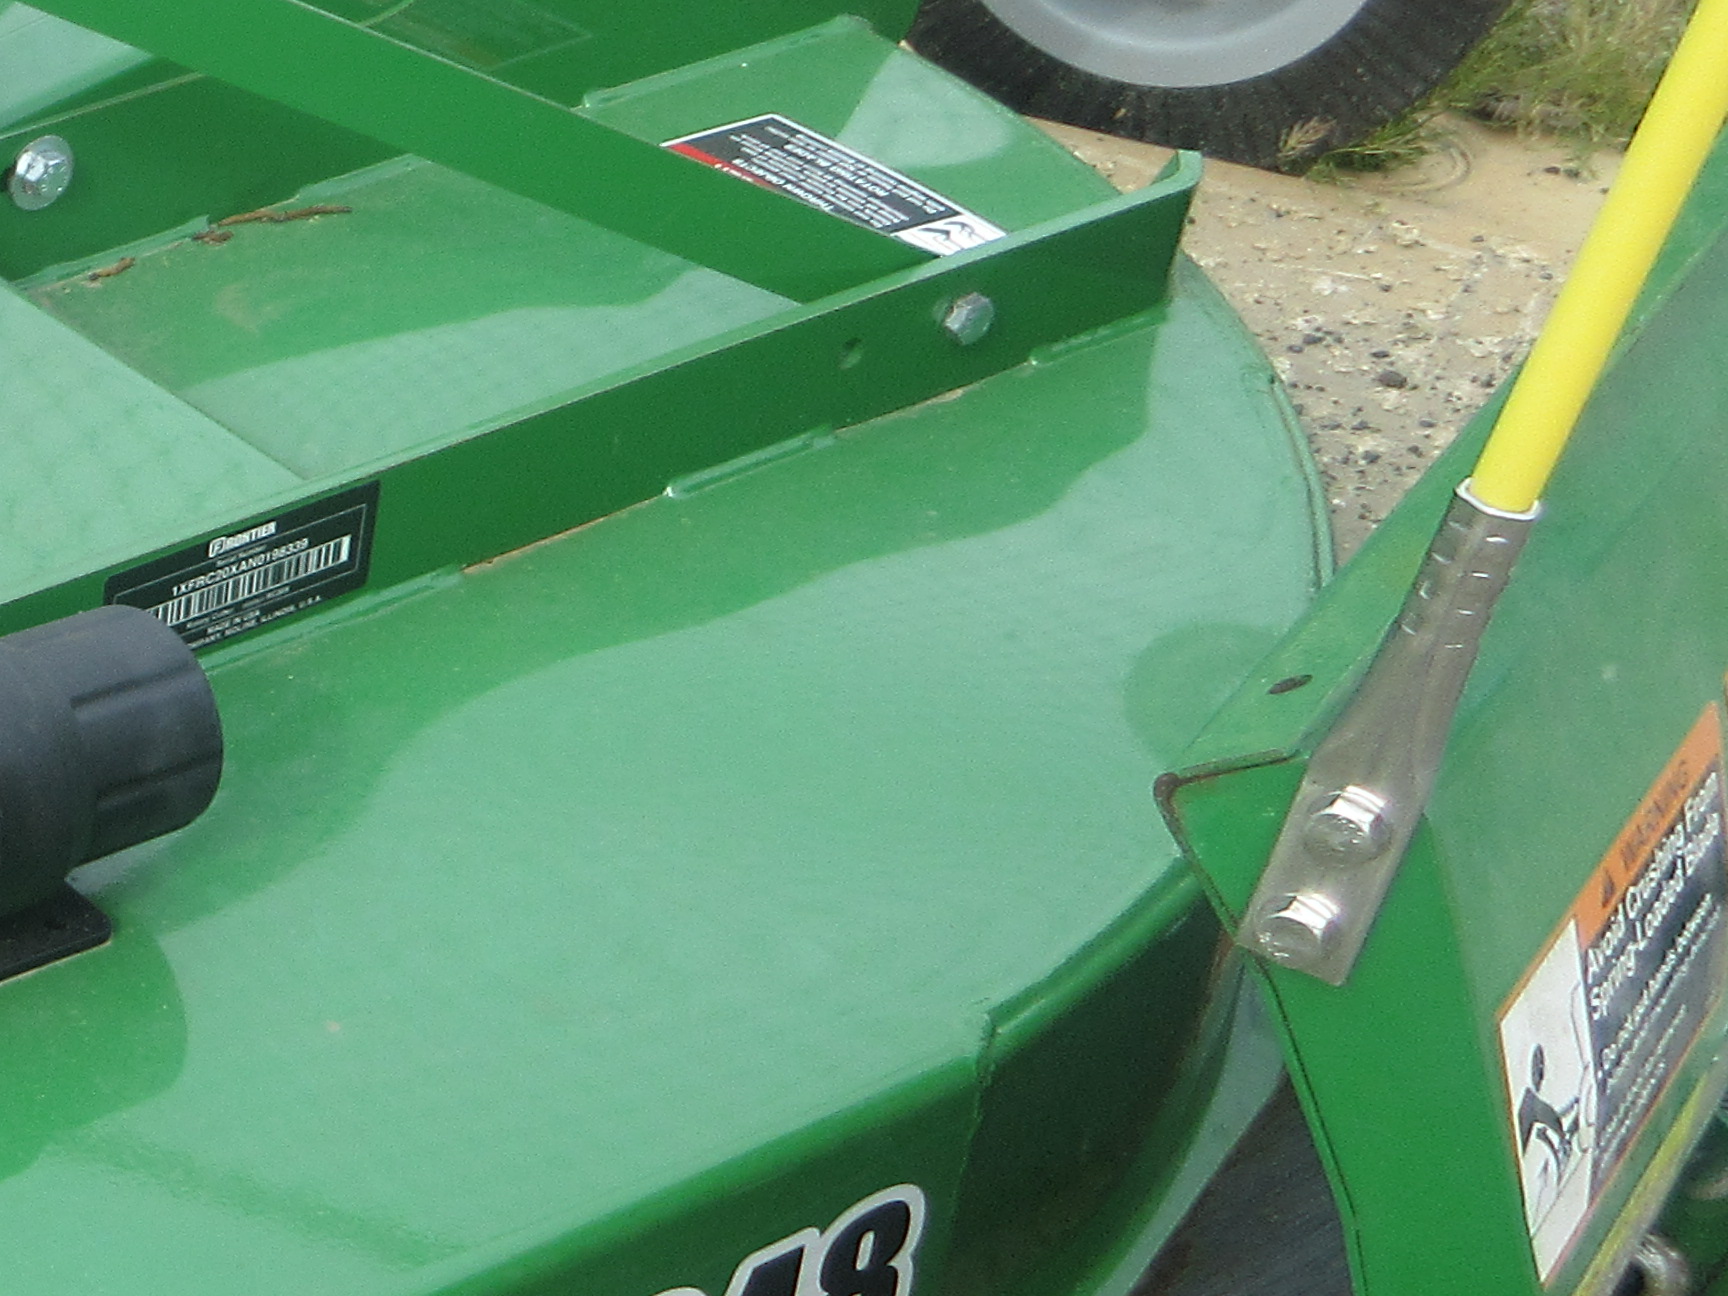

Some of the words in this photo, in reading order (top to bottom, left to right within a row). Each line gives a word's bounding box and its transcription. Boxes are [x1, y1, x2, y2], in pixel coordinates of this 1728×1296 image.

[208, 521, 277, 558] FRONTIER
[1587, 903, 1625, 983] Avoid
[1626, 823, 1685, 919] Crushing
